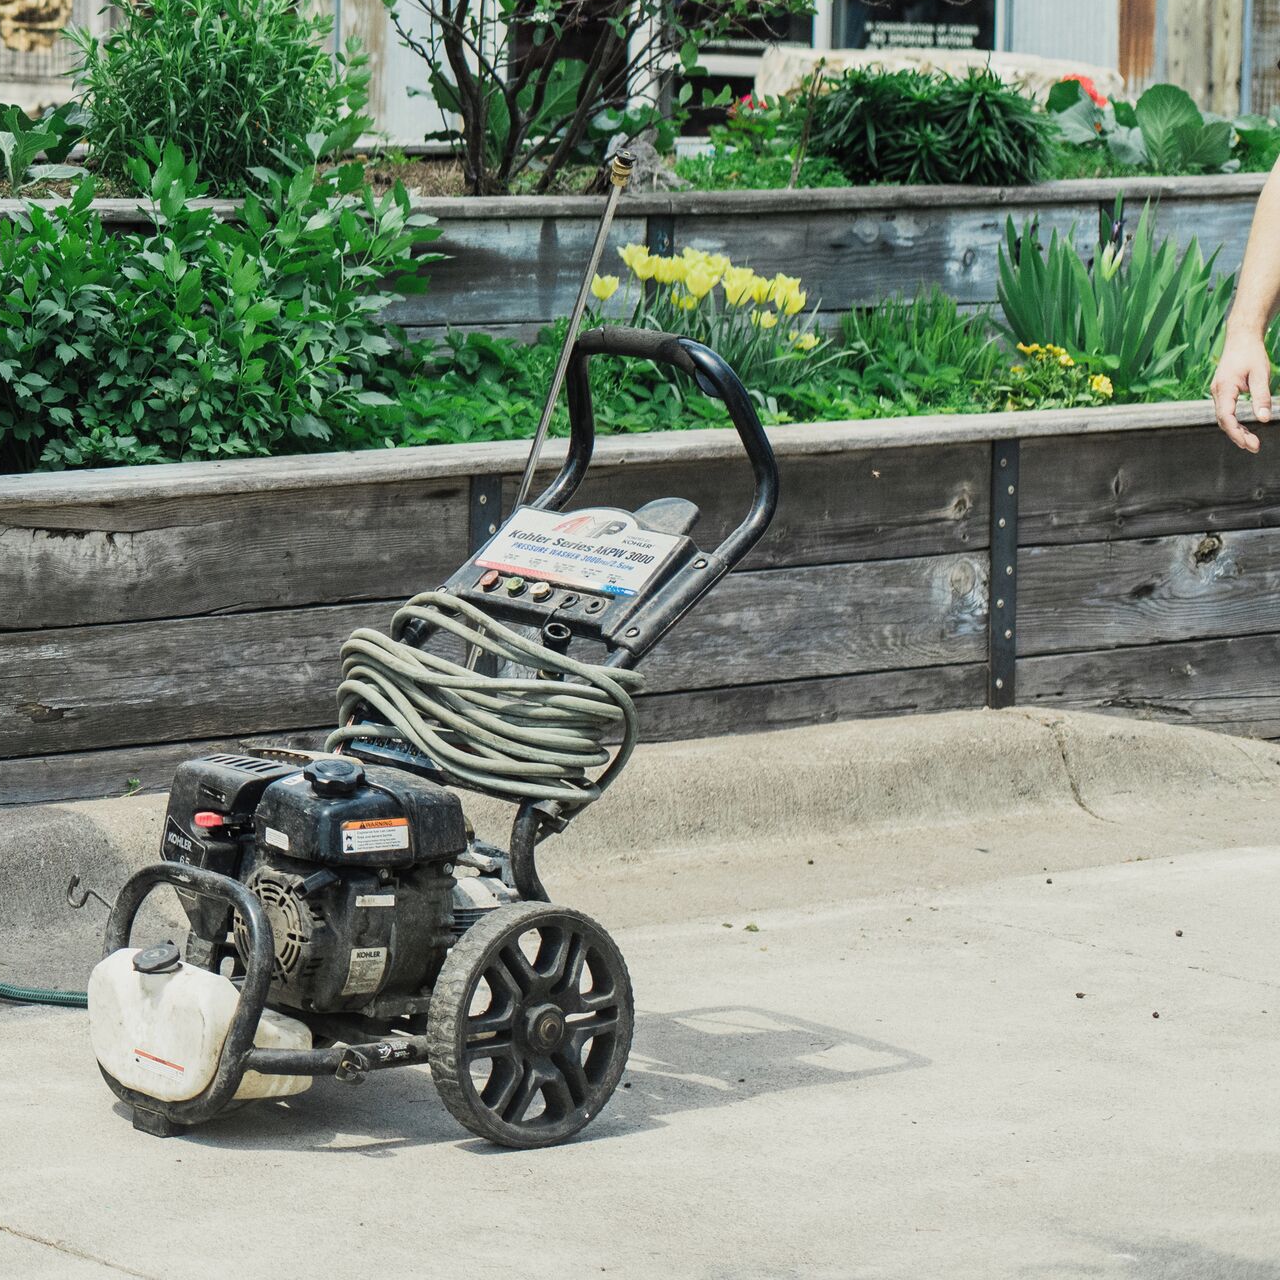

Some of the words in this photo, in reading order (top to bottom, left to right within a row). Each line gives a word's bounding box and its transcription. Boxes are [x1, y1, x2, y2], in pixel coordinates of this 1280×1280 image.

[508, 529, 552, 545] Kohler
[552, 536, 595, 553] Series
[594, 545, 628, 560] AKPW
[625, 551, 655, 565] 3000
[511, 542, 549, 555] PRESSURE
[550, 548, 581, 561] WASHER
[365, 820, 393, 828] WARNING
[167, 831, 192, 852] KOHLER
[356, 950, 381, 959] KOHLER
